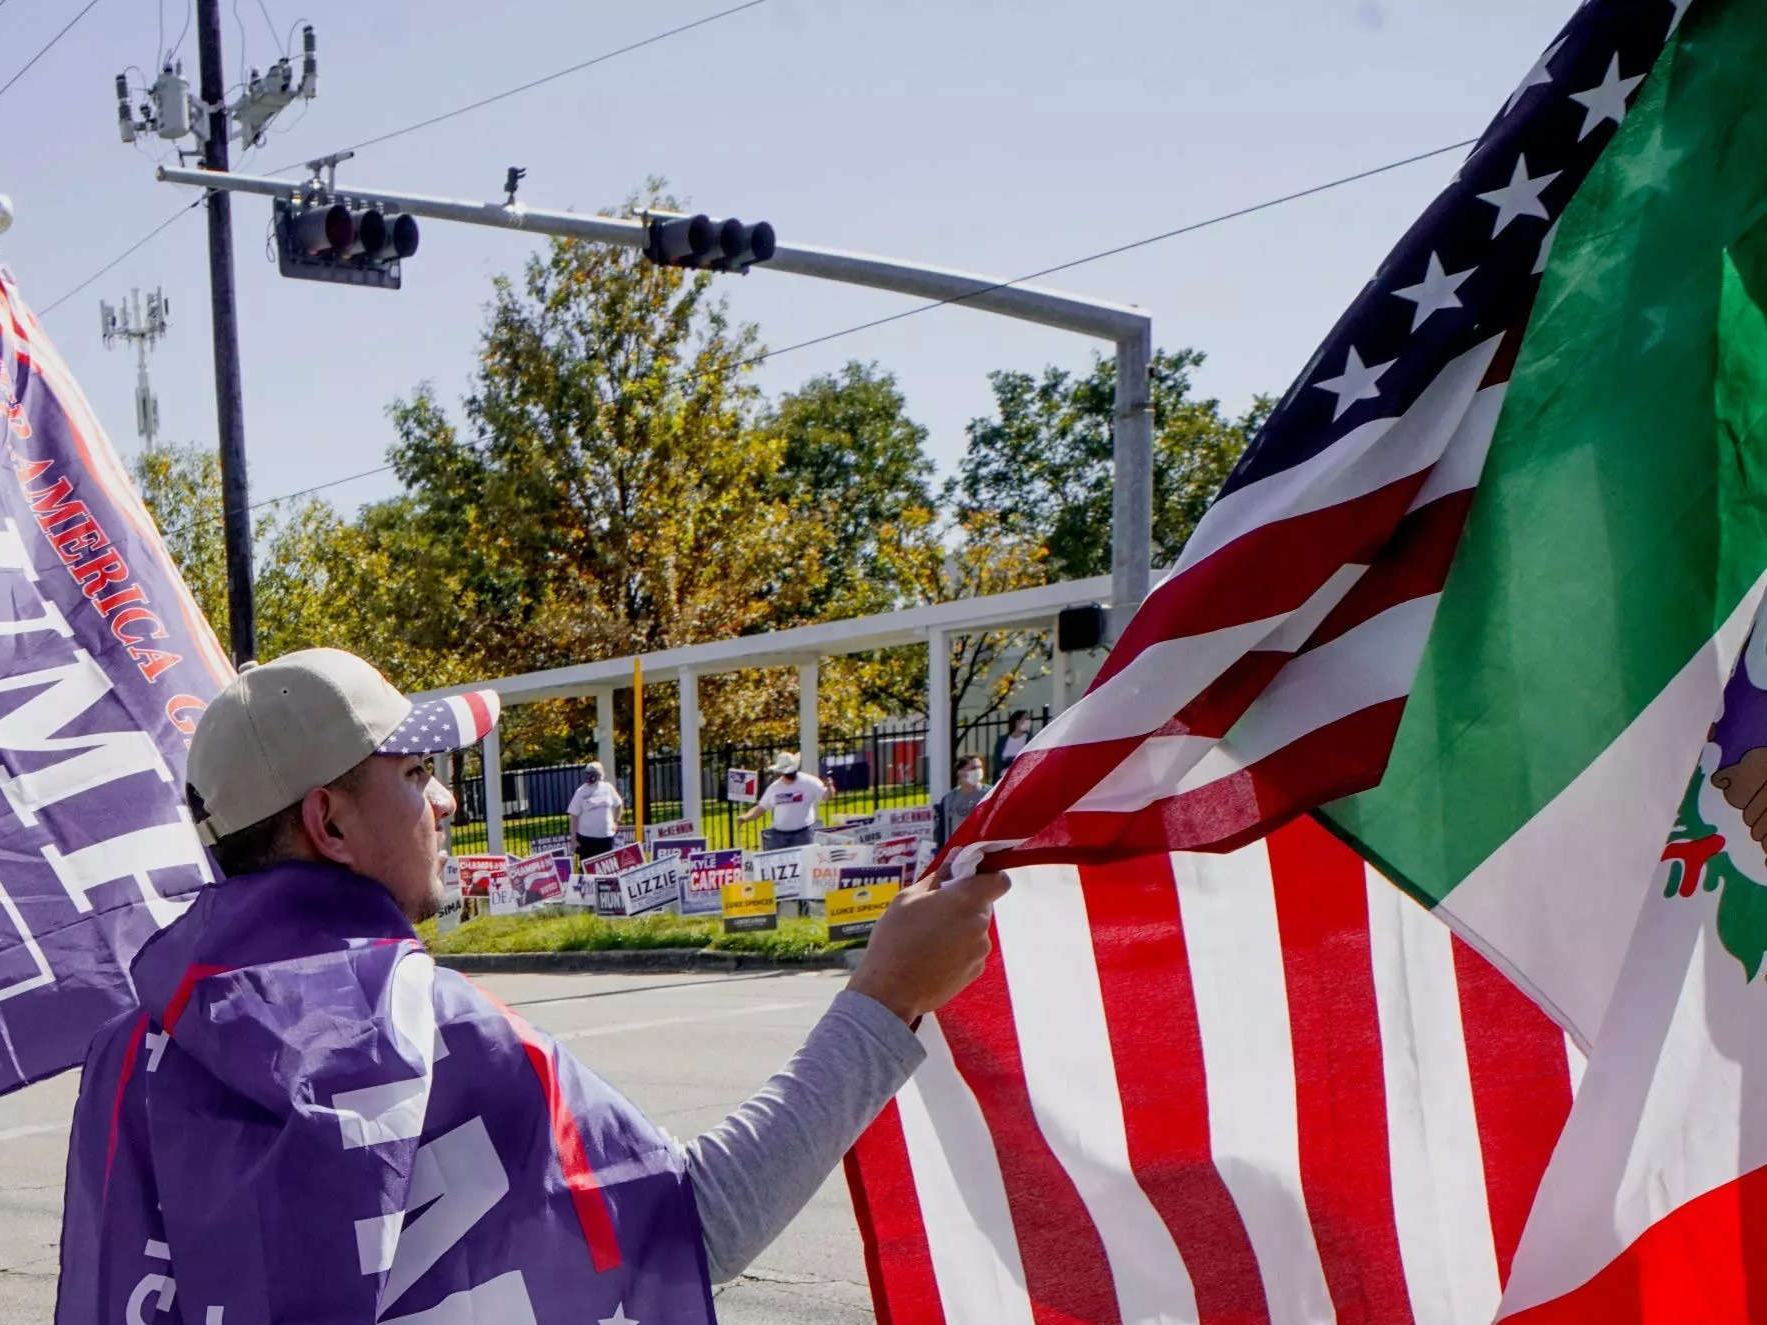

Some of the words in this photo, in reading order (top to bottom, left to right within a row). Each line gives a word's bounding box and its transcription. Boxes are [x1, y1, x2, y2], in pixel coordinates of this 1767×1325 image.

[9, 446, 184, 684] AMERICA
[690, 858, 717, 870] KYLE
[761, 863, 800, 881] LIZZ
[627, 870, 676, 899] LIZZIE
[690, 868, 742, 891] CARTER
